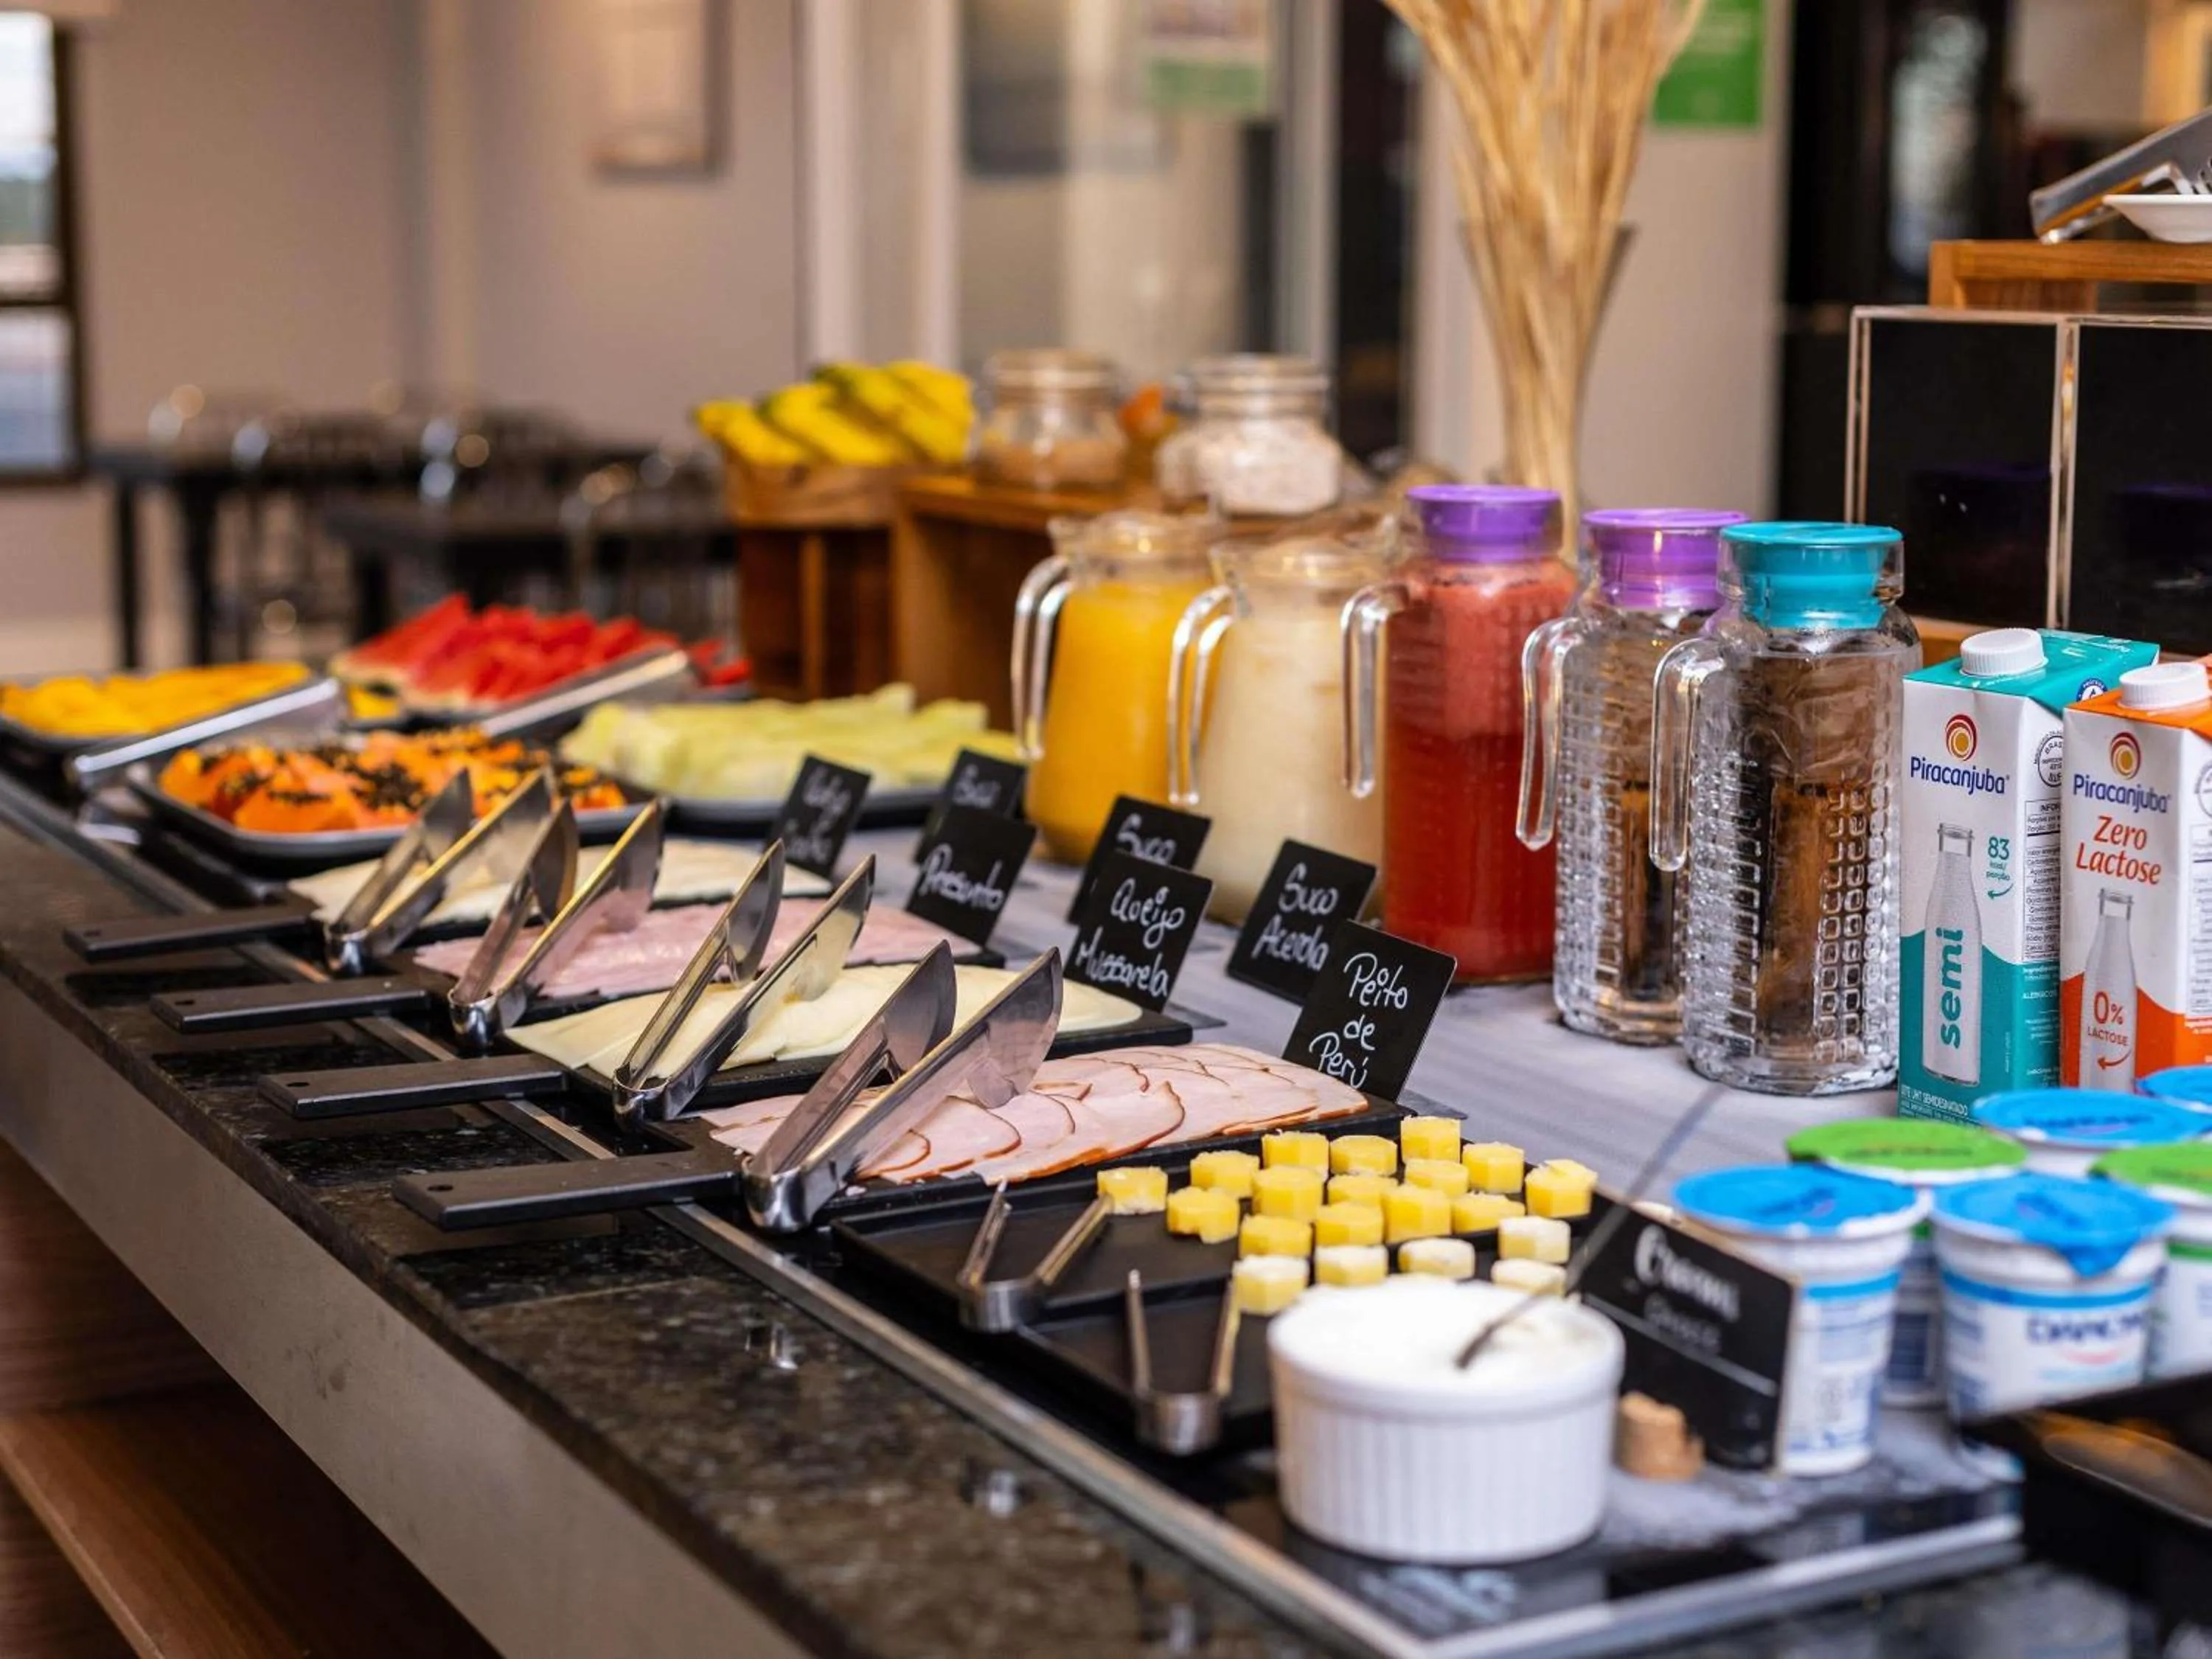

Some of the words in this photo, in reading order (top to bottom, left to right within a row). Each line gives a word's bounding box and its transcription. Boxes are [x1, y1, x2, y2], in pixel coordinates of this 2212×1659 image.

[1910, 757, 2006, 795] Piracanjuba
[2073, 773, 2168, 813] Piracanjuba
[1988, 836, 2010, 860] 83
[2093, 815, 2147, 850] Zero
[2076, 842, 2162, 885] Lactose
[1278, 862, 1339, 916] Suco
[1251, 913, 1330, 972] Acerola
[1343, 952, 1408, 1009] Peito
[1935, 927, 1964, 1049] semi
[2094, 992, 2124, 1025] 0%
[1343, 1014, 1376, 1051] de
[2087, 1026, 2129, 1046] LACTOSE
